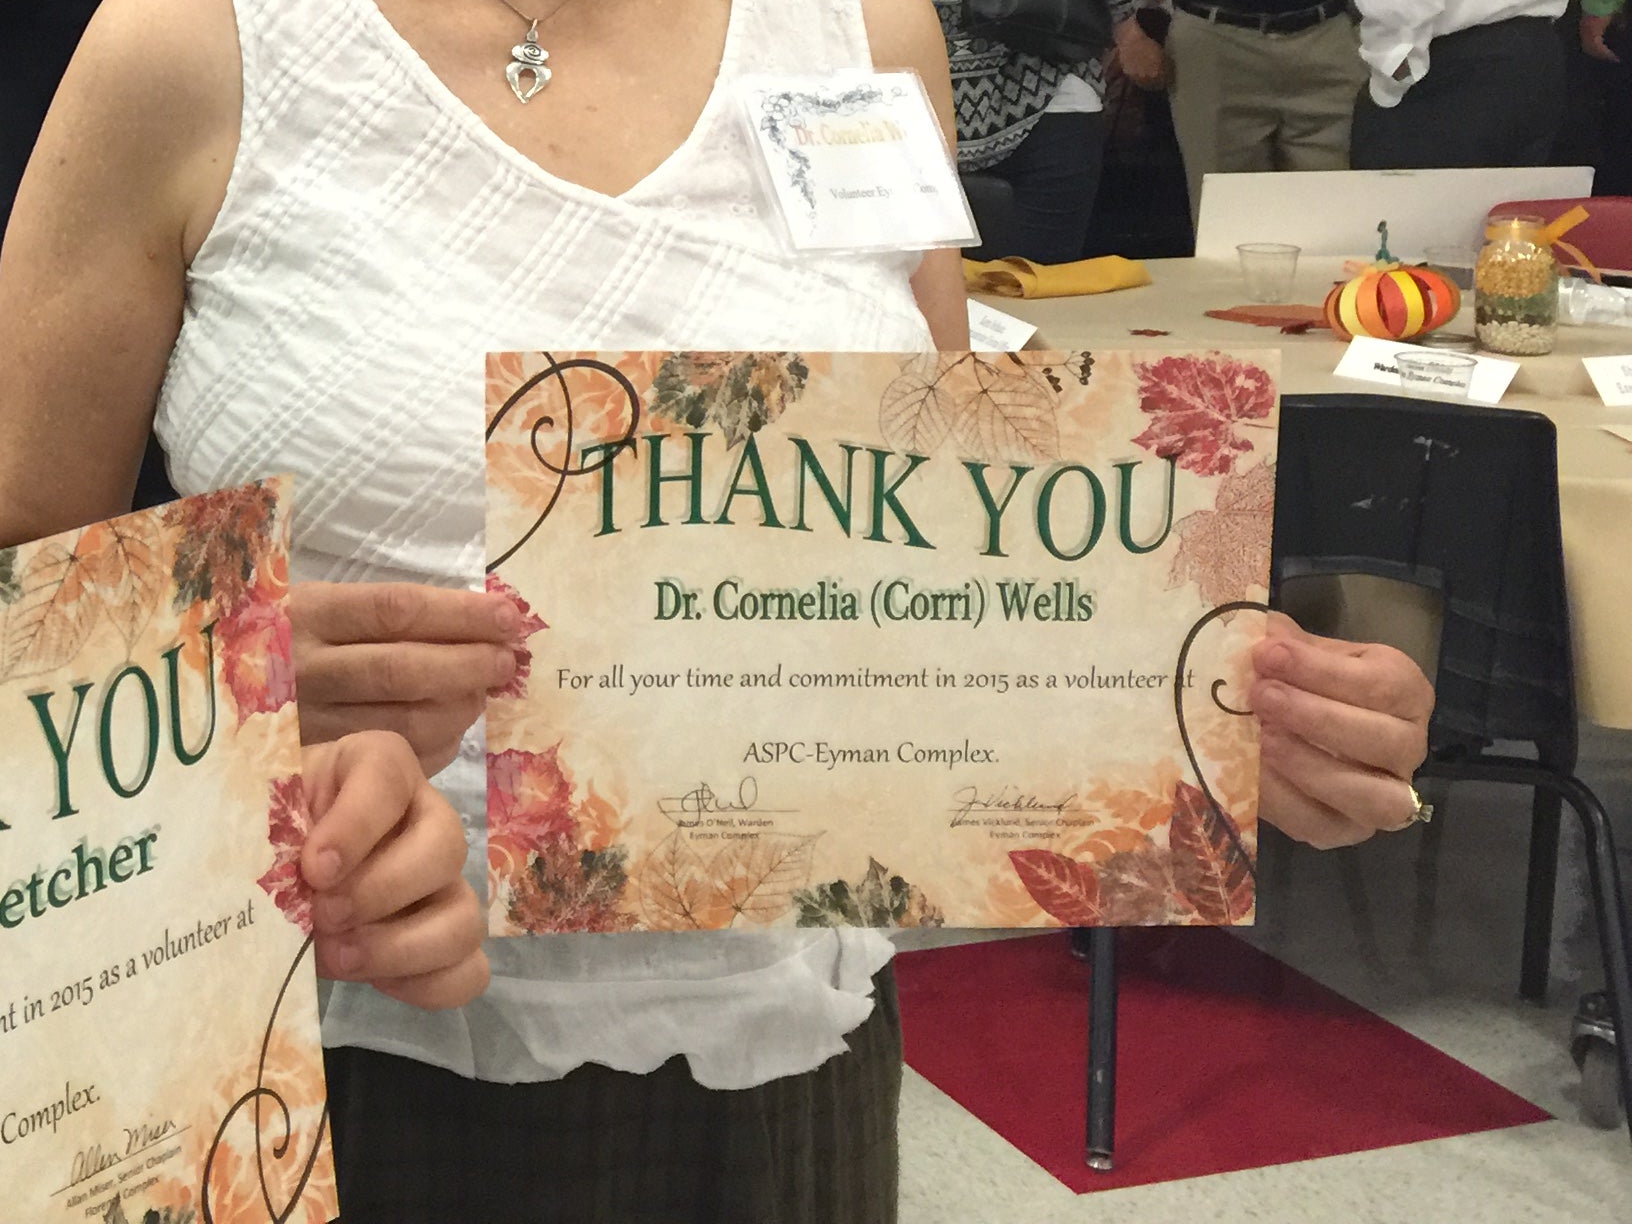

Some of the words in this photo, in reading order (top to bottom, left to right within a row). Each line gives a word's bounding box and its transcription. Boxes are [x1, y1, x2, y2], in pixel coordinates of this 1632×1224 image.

[829, 187, 876, 200] Volunteer
[579, 431, 937, 551] THANK
[961, 453, 1178, 562] YOU
[654, 580, 702, 622] Dr.
[712, 579, 859, 622] Cornelia
[870, 578, 985, 629] (Corri)
[996, 580, 1094, 623] Wells
[557, 668, 594, 690] For
[598, 664, 625, 689] all
[629, 671, 680, 697] your
[685, 667, 734, 689] time
[739, 663, 782, 689] and
[788, 667, 929, 689] commitment
[936, 667, 956, 688] in
[963, 673, 1010, 694] 2015
[1016, 674, 1039, 689] as
[1045, 674, 1058, 689] a
[1065, 664, 1169, 690] volunteer
[28, 621, 218, 821] YOU
[743, 740, 890, 771] ASPC-Eyman
[897, 738, 1000, 771] Complex.
[689, 831, 719, 840] Eyman
[721, 831, 759, 840] Complex
[737, 817, 774, 827] Warden
[989, 830, 1019, 840] Eyman
[1022, 830, 1061, 840] Complex
[23, 995, 45, 1024] in
[50, 978, 95, 1013] 2015
[98, 965, 121, 990] as
[125, 958, 138, 978] a
[141, 916, 233, 970] volunteer
[236, 898, 256, 932] at
[0, 1080, 102, 1146] Complex.
[117, 1163, 145, 1184] Senior
[145, 1145, 182, 1171] Chaplain
[122, 1175, 160, 1200] Complex
